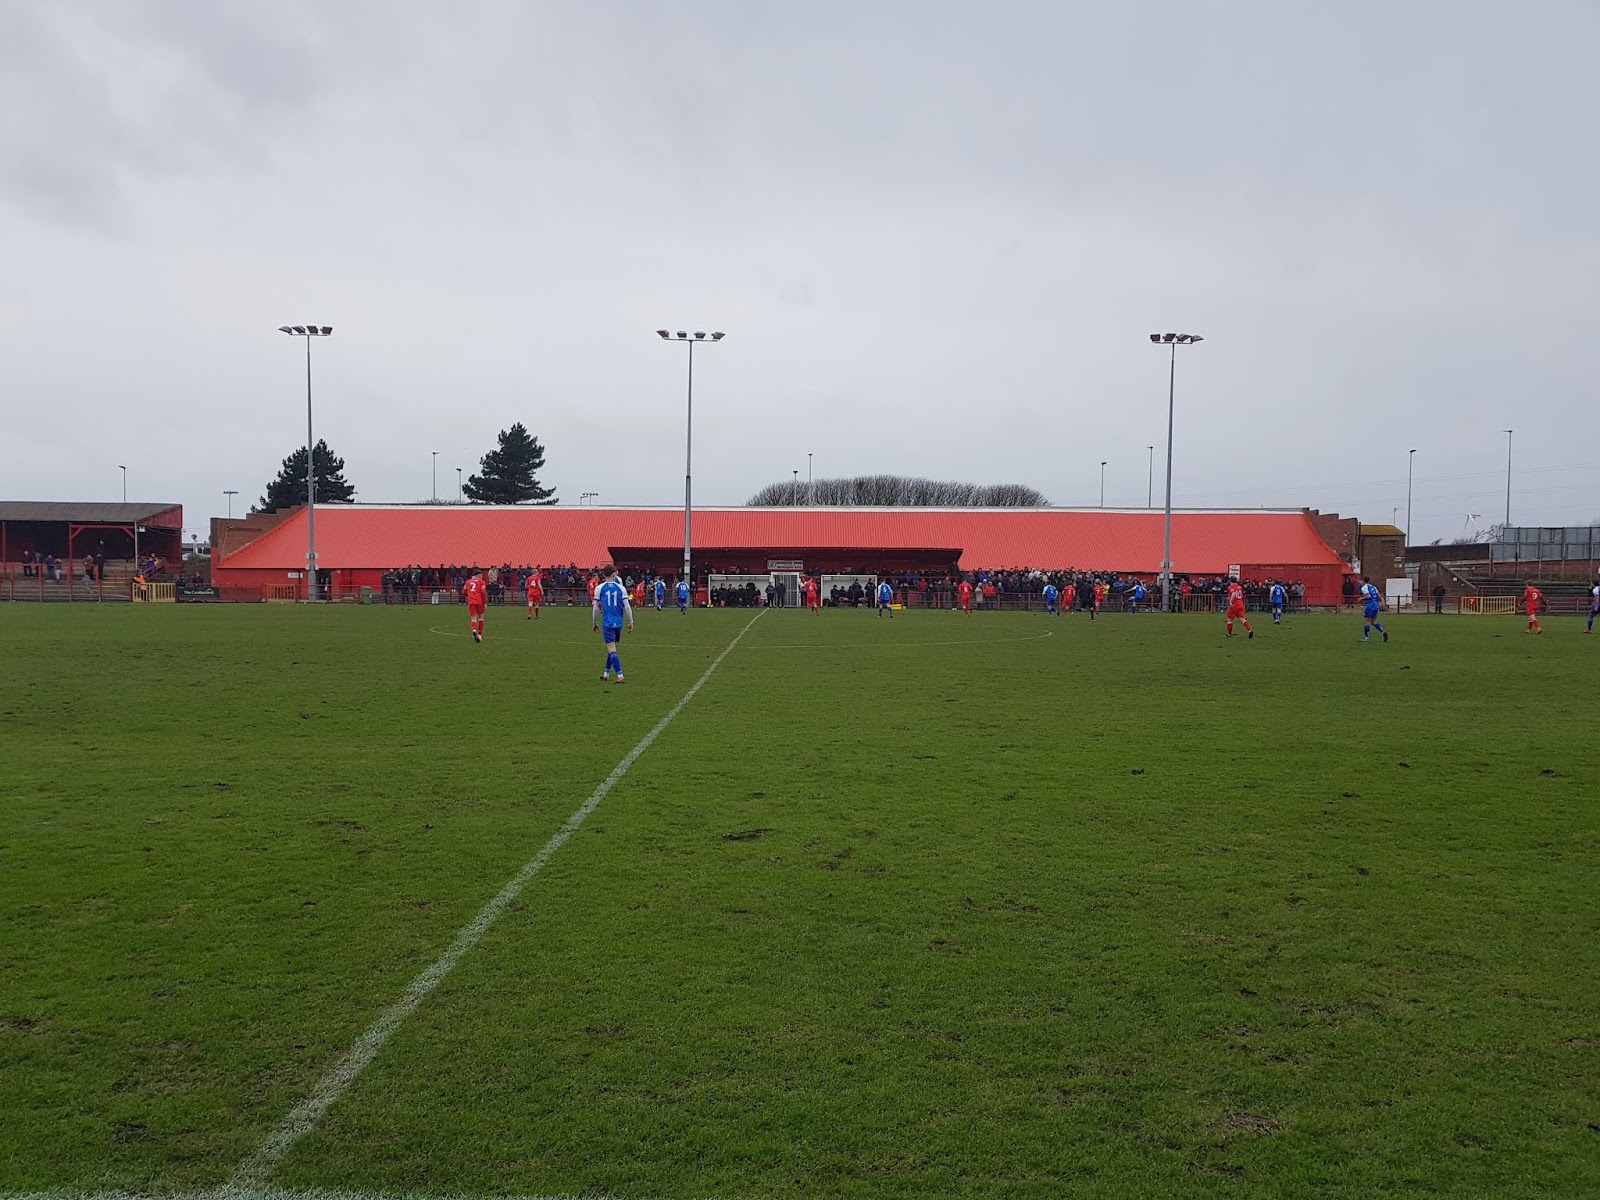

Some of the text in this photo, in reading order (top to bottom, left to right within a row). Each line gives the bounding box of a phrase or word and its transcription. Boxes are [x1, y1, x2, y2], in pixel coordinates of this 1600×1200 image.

[470, 582, 477, 592] 2
[605, 590, 618, 607] 11
[1236, 590, 1243, 599] 10
